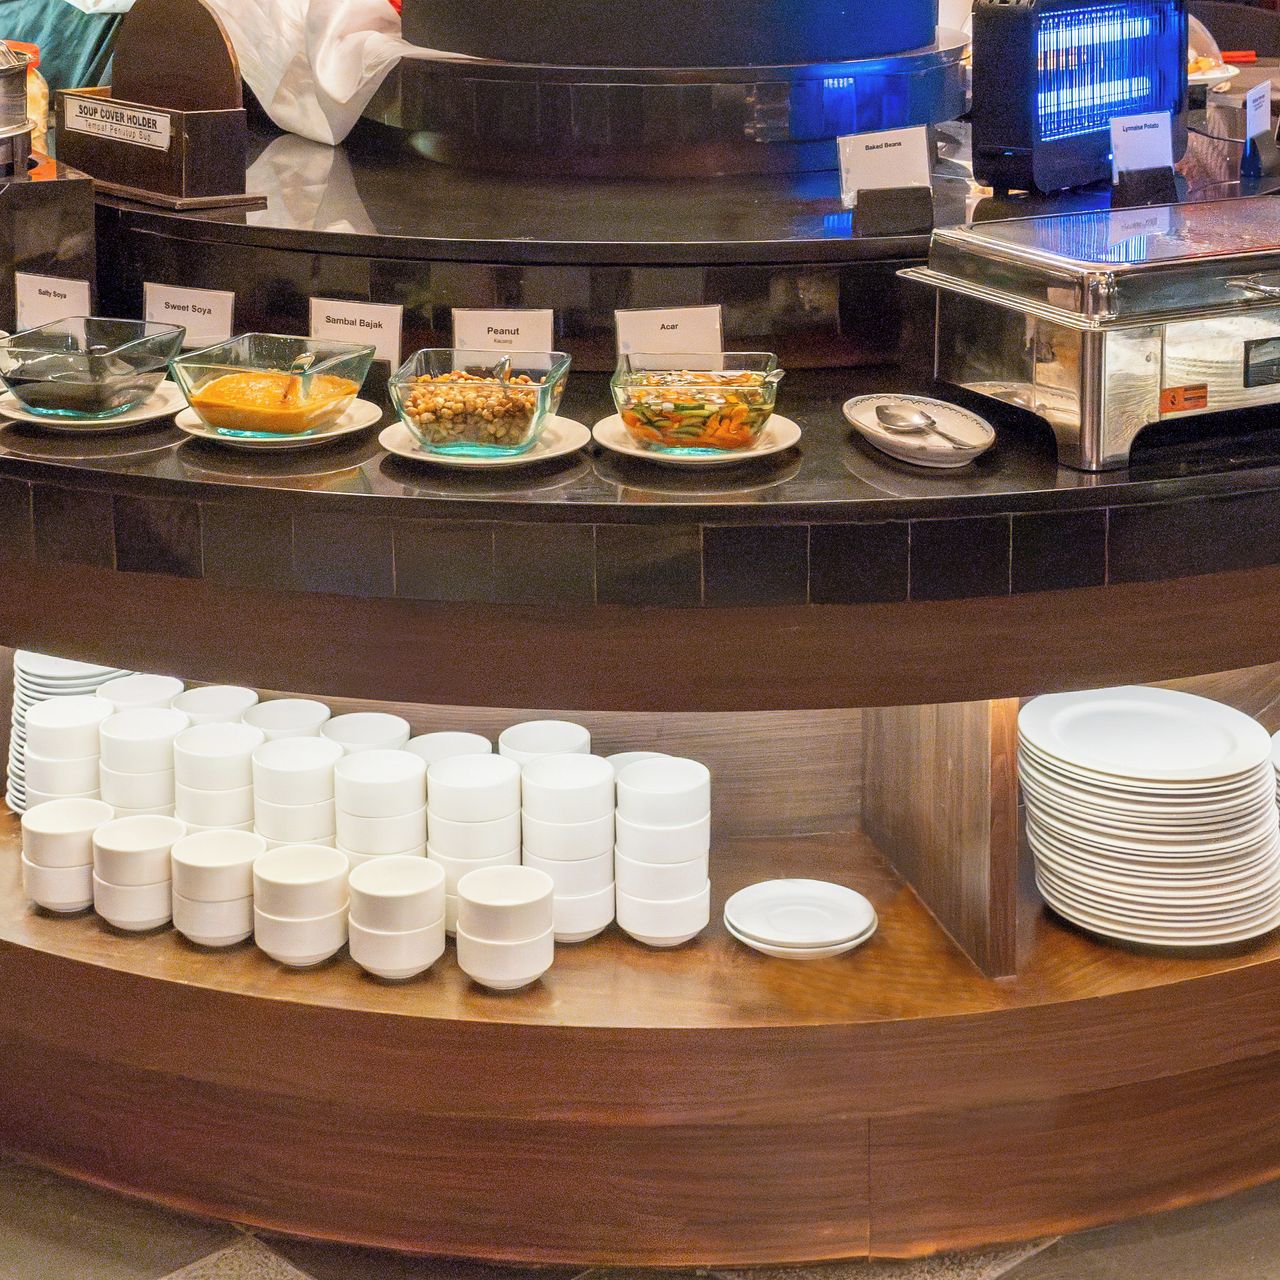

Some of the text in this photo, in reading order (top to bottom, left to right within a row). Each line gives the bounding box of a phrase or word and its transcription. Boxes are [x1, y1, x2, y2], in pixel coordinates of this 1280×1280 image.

[78, 104, 158, 130] SOUP COVER HOLDER
[864, 141, 902, 151] Baked Beans
[53, 290, 67, 299] Soya
[164, 301, 213, 316] Sweet Soya
[325, 315, 384, 330] Sambal Bajak
[486, 326, 520, 336] Peanut
